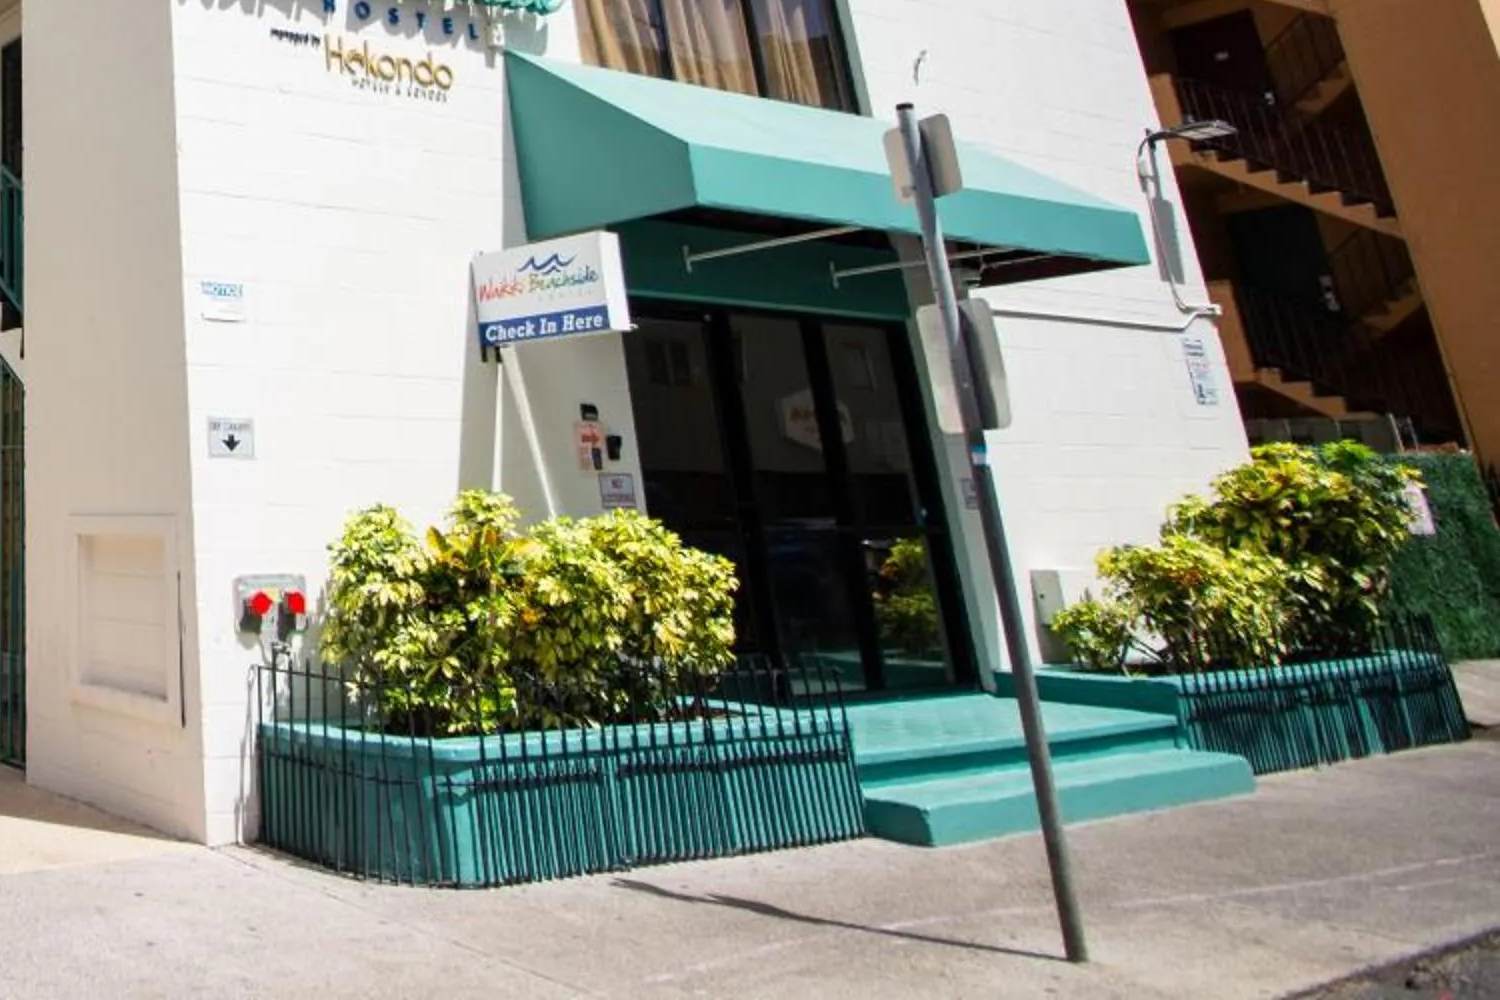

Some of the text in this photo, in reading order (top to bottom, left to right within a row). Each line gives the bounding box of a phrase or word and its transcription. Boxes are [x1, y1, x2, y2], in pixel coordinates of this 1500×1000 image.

[485, 312, 604, 342] Check In Here
